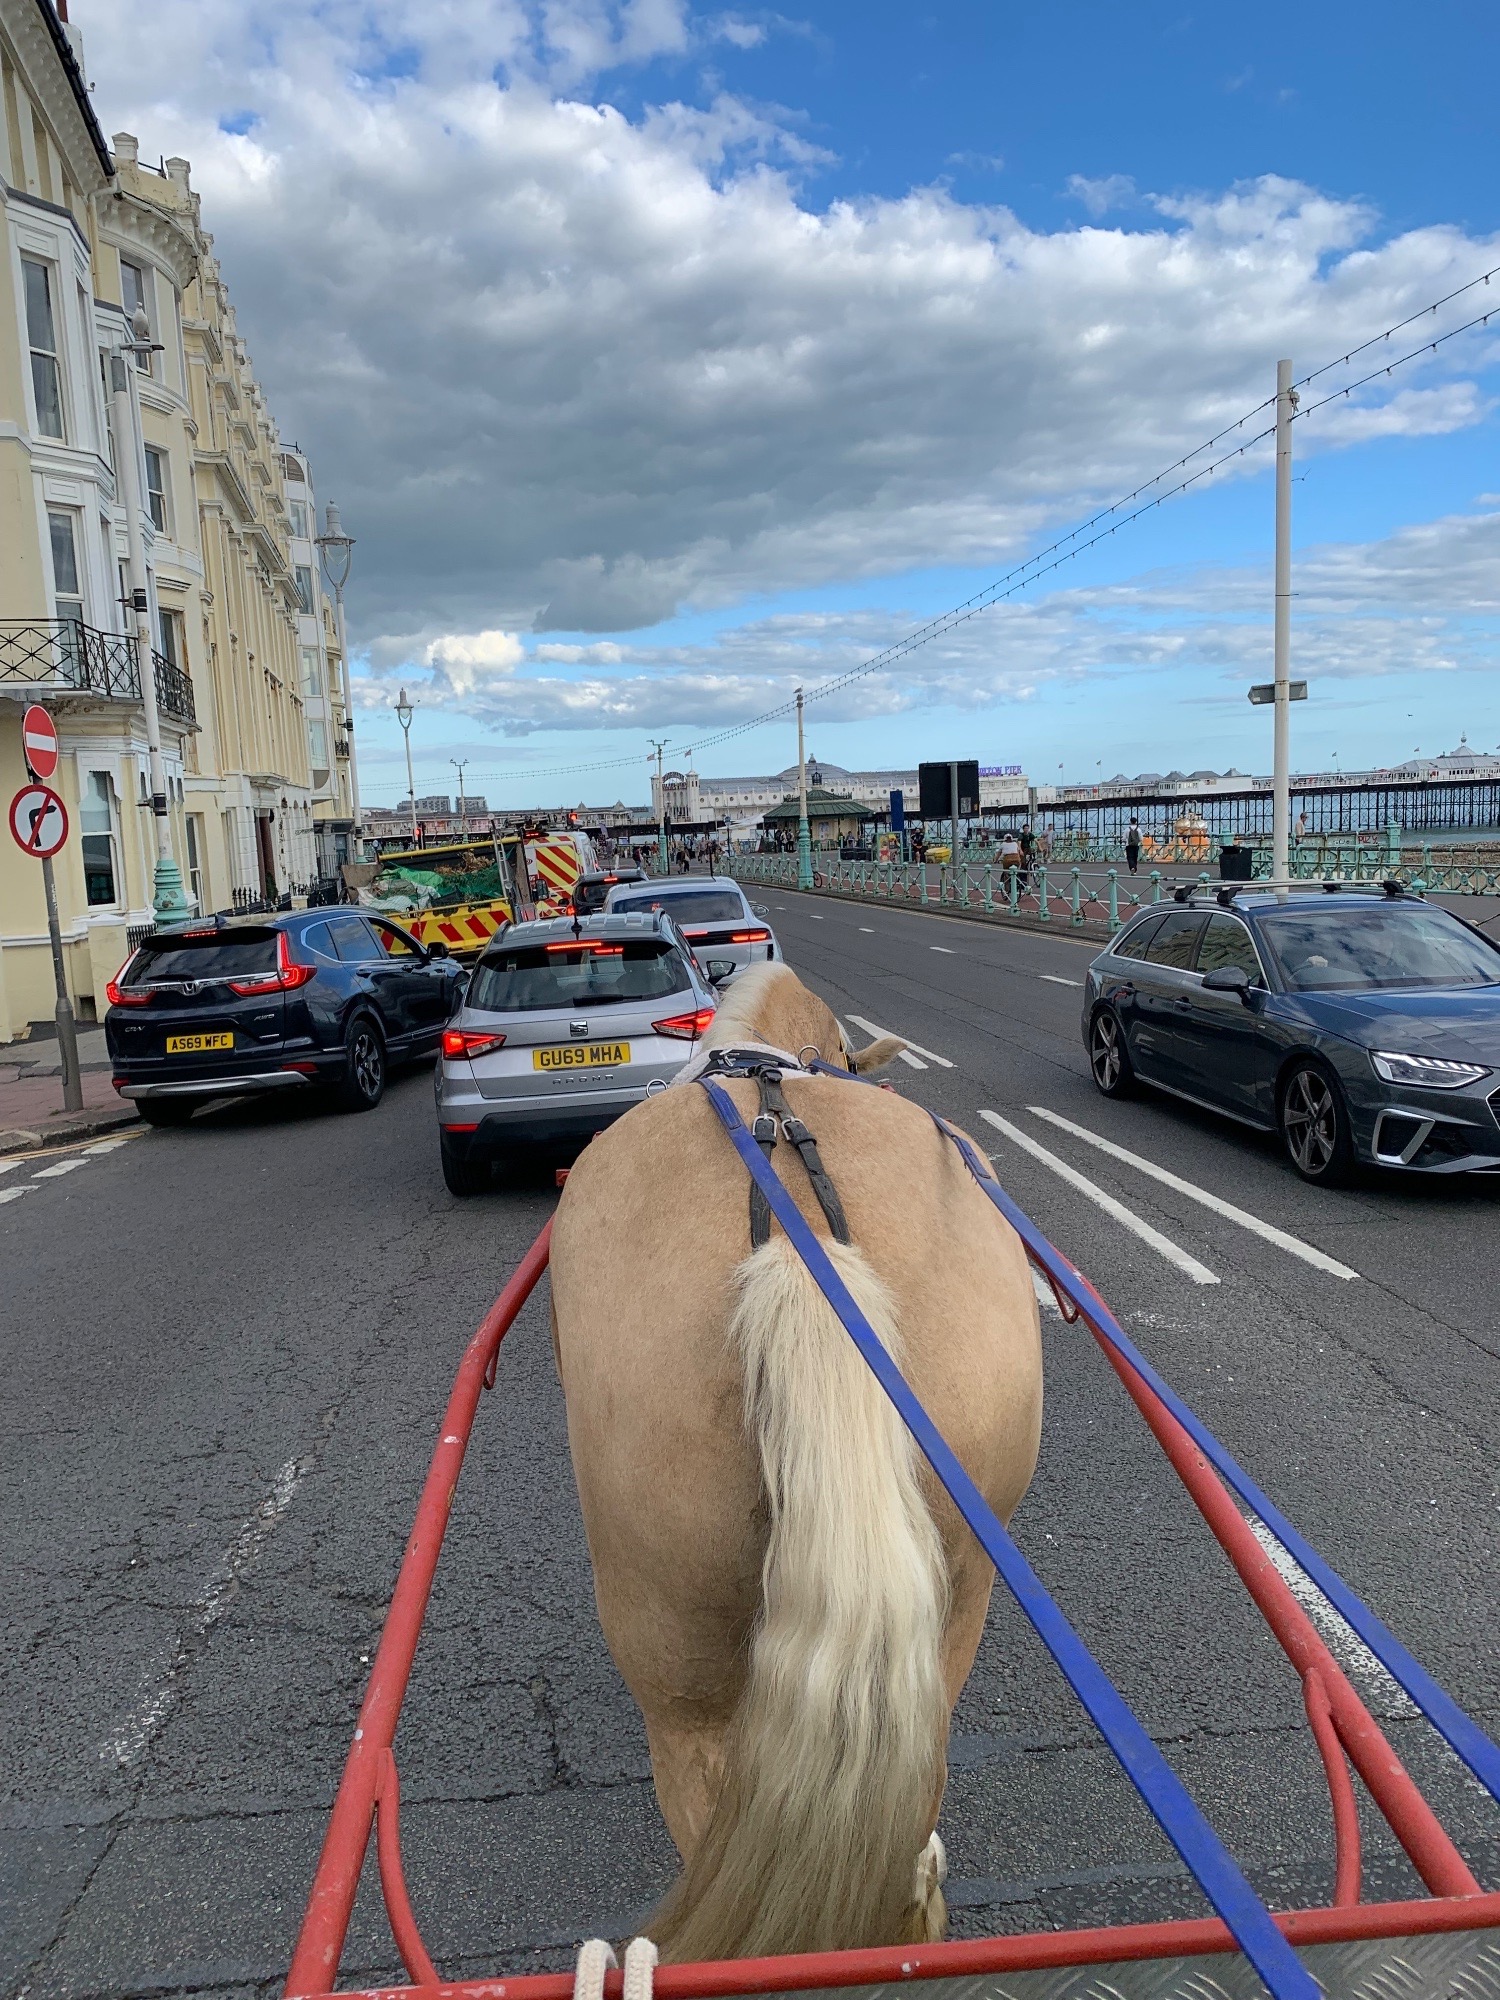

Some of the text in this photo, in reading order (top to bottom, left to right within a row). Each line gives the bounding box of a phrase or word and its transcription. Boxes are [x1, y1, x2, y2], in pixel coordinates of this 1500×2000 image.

[1005, 765, 1022, 775] PIER
[171, 1035, 228, 1050] AS69 WFC
[540, 1045, 623, 1067] GU69 MHA
[552, 1074, 614, 1085] ARONA
